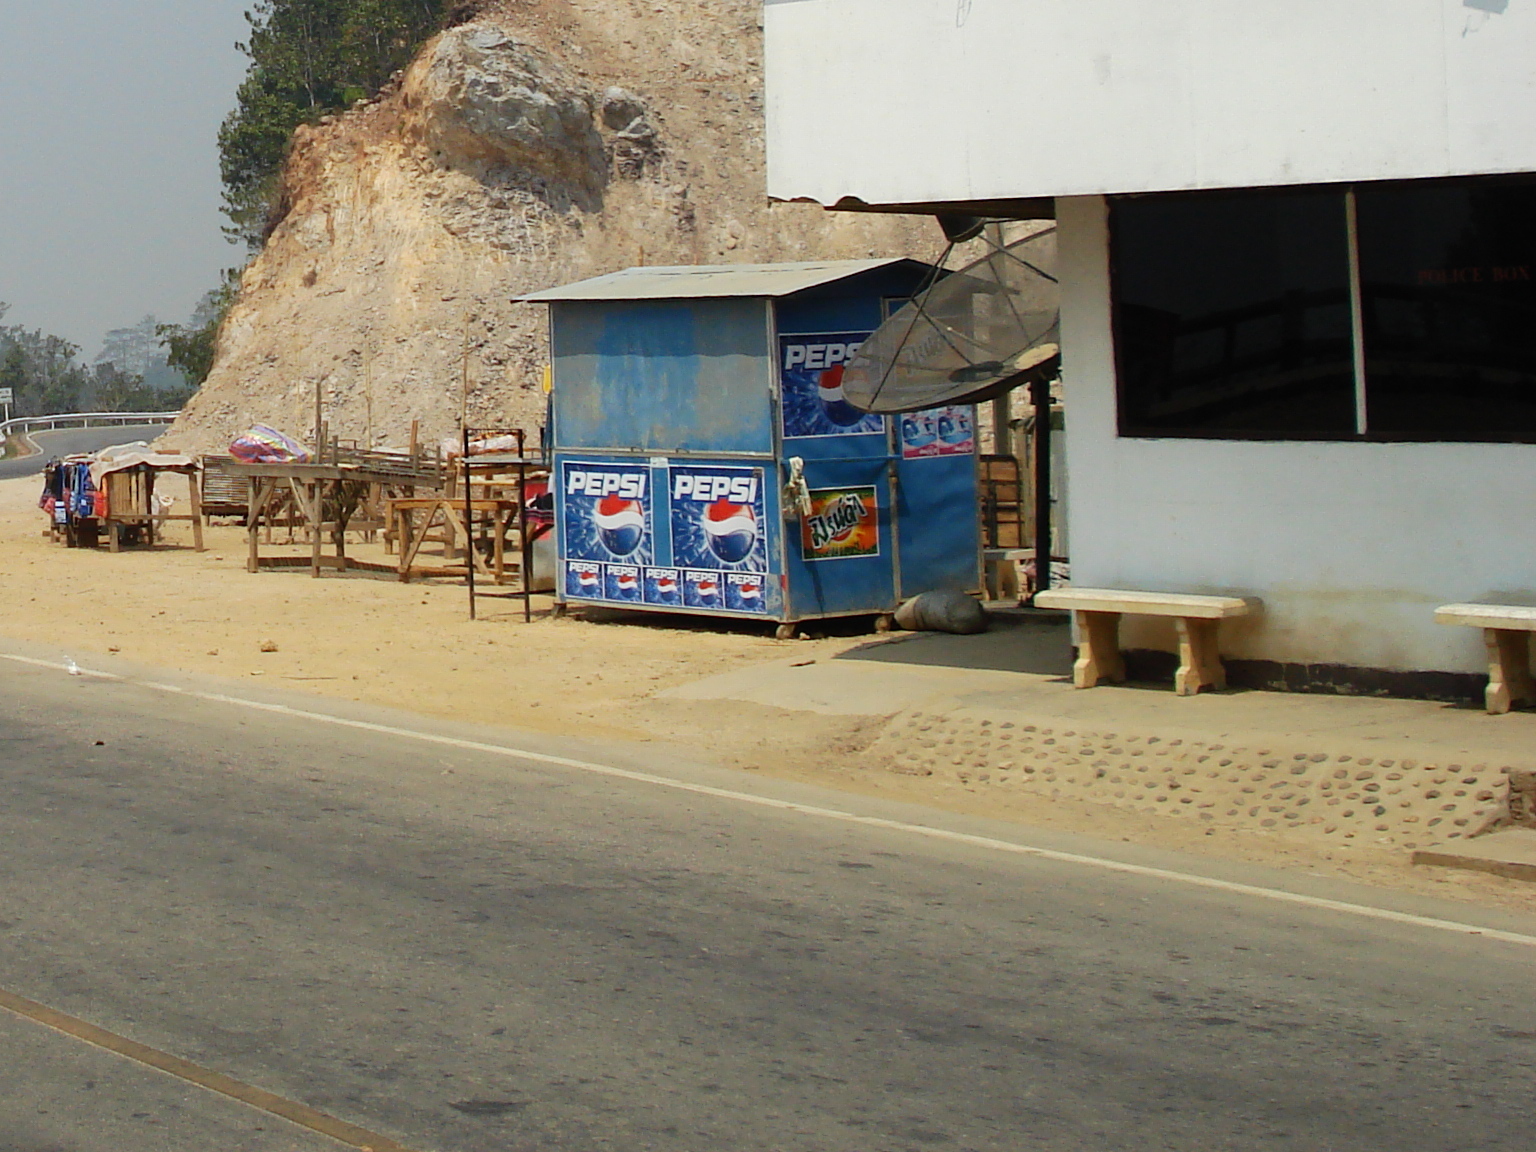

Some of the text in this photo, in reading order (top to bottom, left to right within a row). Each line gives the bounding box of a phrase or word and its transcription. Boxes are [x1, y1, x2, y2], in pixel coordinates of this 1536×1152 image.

[1417, 265, 1531, 285] POLICE BOX
[785, 342, 871, 370] PEPS
[567, 470, 647, 499] PEPSI
[673, 474, 758, 503] PEPSI
[569, 561, 600, 574] PEPSI
[607, 565, 639, 577] PEPSI
[645, 568, 678, 580] PEPSI
[685, 571, 719, 583] PEPSI
[727, 573, 762, 586] PEPSI
